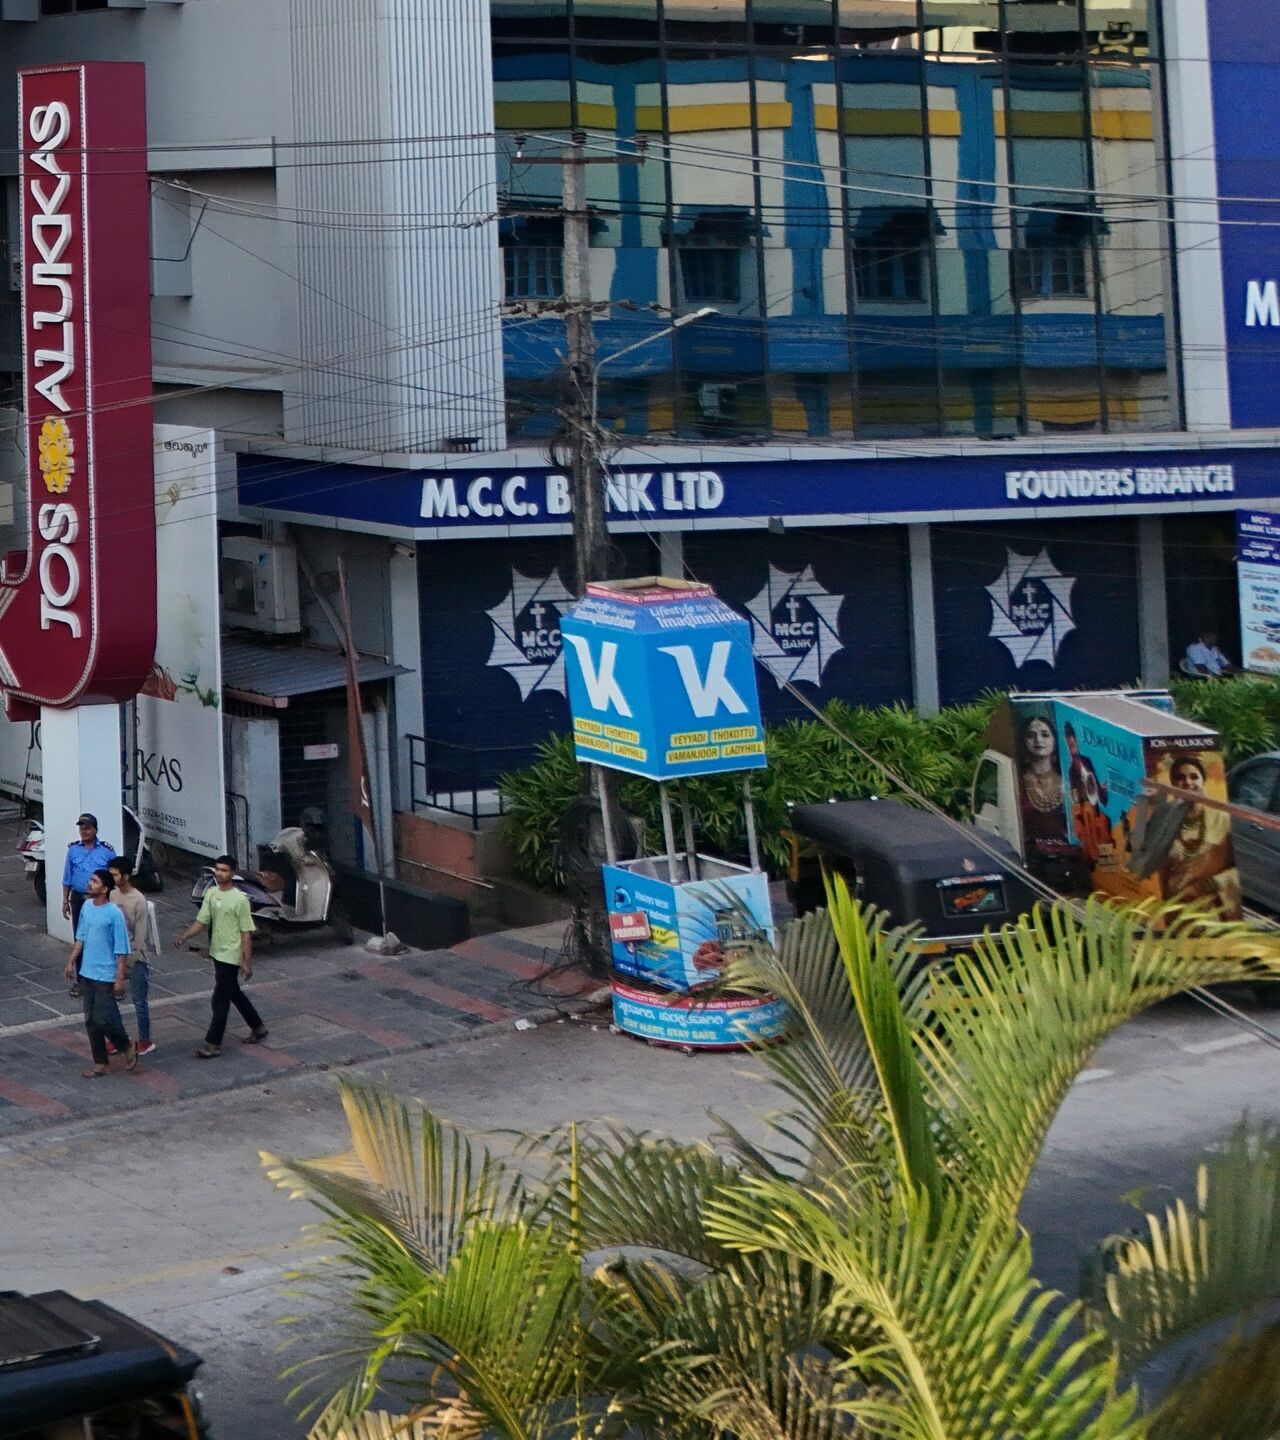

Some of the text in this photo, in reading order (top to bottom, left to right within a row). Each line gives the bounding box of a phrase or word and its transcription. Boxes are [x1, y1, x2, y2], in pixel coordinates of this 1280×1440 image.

[29, 101, 82, 639] JOS ALUKKAS
[1005, 464, 1235, 499] FOUNDERS BRANCH
[420, 471, 725, 518] M.C.C. BNK LTD
[649, 602, 694, 617] Lifestyle
[1012, 603, 1049, 620] MCC
[656, 610, 742, 629] Imagination
[775, 622, 815, 637] MCC
[522, 629, 561, 648] MCC
[781, 637, 813, 649] BANK
[526, 646, 559, 659] BANK
[672, 727, 755, 745] YEYYADI THOKOTTU
[667, 743, 763, 762] VAMANJOOR LADYHILL
[622, 916, 634, 926] NO
[613, 926, 646, 938] PARKING
[667, 1028, 689, 1039] STAY
[692, 1030, 717, 1040] SAFE
